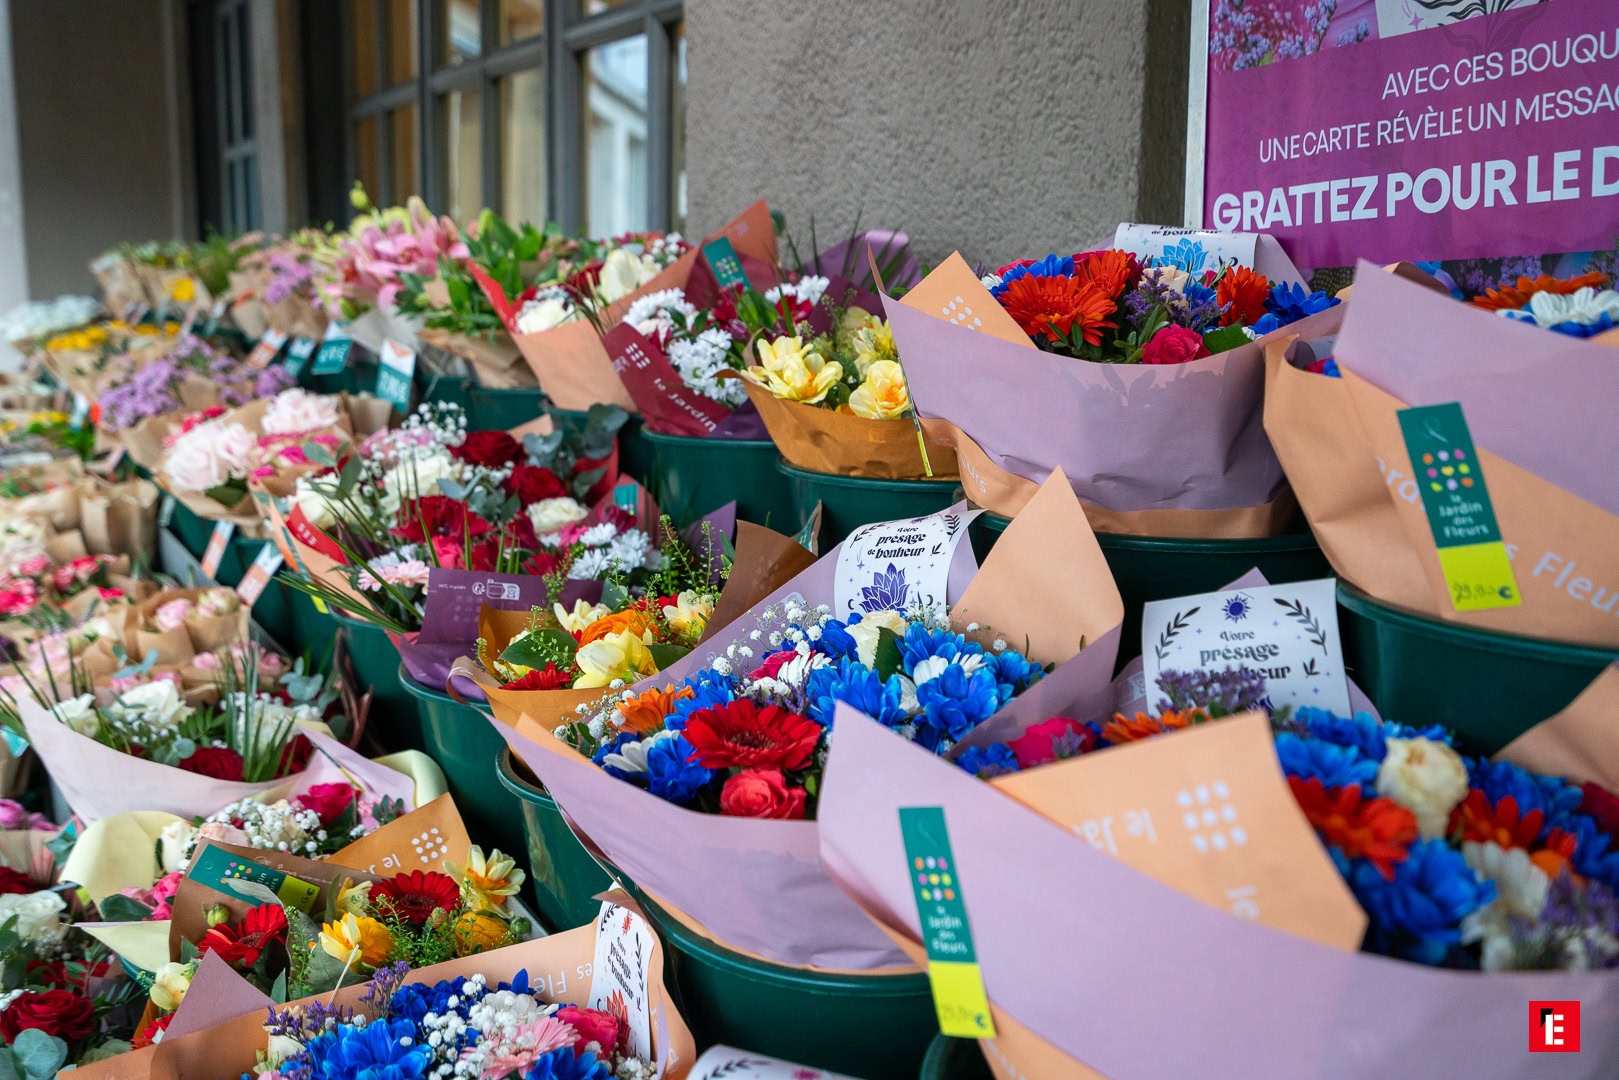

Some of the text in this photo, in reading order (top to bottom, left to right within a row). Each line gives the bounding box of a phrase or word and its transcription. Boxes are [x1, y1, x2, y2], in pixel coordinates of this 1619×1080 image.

[1381, 63, 1450, 100] AVEC
[1454, 52, 1504, 87] CES
[1259, 134, 1300, 163] UNE
[1302, 122, 1370, 157] CARTE
[1376, 106, 1462, 147] RÉVÈLE
[1467, 99, 1506, 132] UN
[1213, 175, 1379, 233] GRATTEZ
[1386, 159, 1519, 218] POUR
[1526, 149, 1582, 204] LE
[653, 377, 718, 433] le Jardin
[1449, 493, 1463, 504] le
[1438, 501, 1484, 518] Jardin
[1453, 515, 1475, 526] des
[1443, 524, 1490, 539] Fleurs
[875, 533, 927, 547] présage
[867, 546, 925, 559] de bonheur
[1219, 630, 1256, 642] Votre
[1199, 643, 1280, 667] présage
[381, 853, 402, 869] le
[928, 915, 963, 929] Jardin
[931, 938, 968, 954] Fleurs
[610, 941, 632, 979] présage
[611, 960, 635, 1000] bonheur
